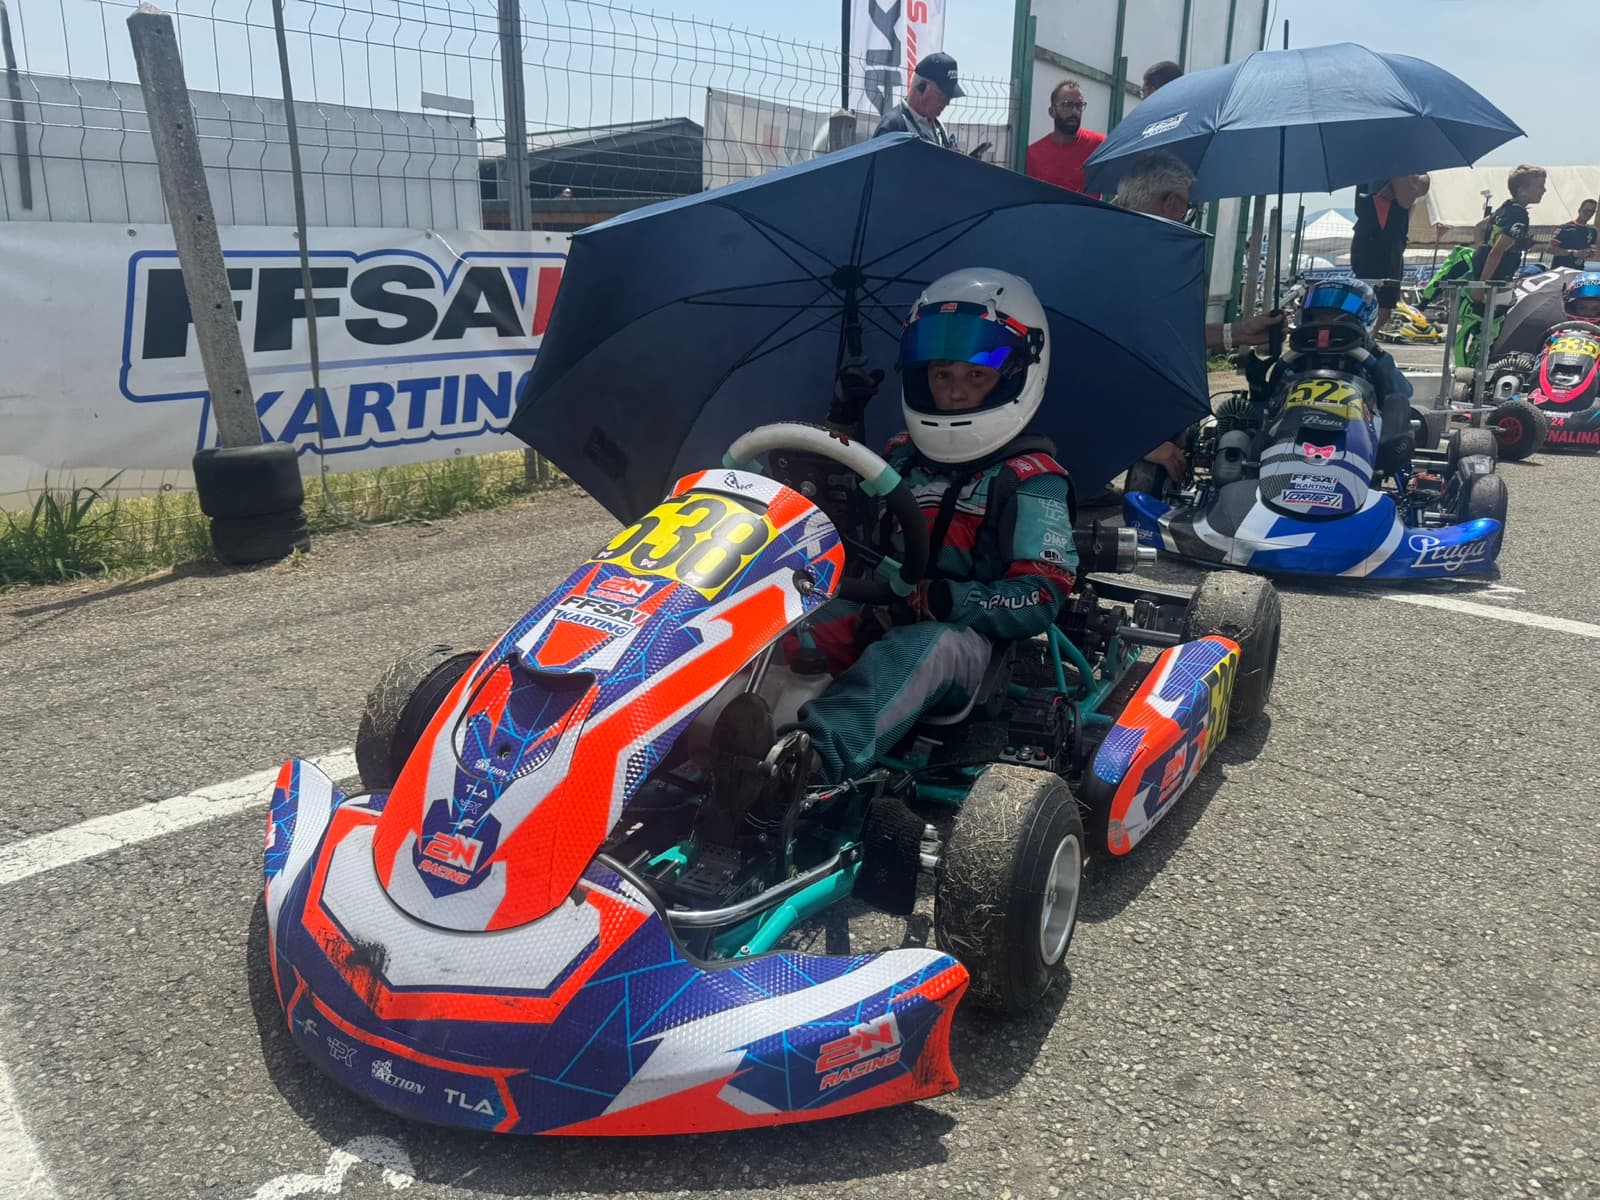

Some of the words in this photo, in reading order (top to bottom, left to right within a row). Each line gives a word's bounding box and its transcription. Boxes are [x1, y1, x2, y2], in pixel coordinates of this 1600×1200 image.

[142, 263, 525, 359] FFSA
[1287, 380, 1361, 405] 522
[215, 369, 538, 447] KARTIN
[1551, 417, 1565, 427] 24
[1545, 430, 1600, 445] NALINA
[1292, 474, 1332, 484] FFSA
[1408, 534, 1487, 572] Praga
[560, 595, 636, 622] FFSA
[558, 611, 629, 635] KARTING
[465, 784, 488, 799] TLA
[418, 859, 471, 885] RACING
[819, 1048, 903, 1091] RACING
[444, 1088, 495, 1116] TLA
